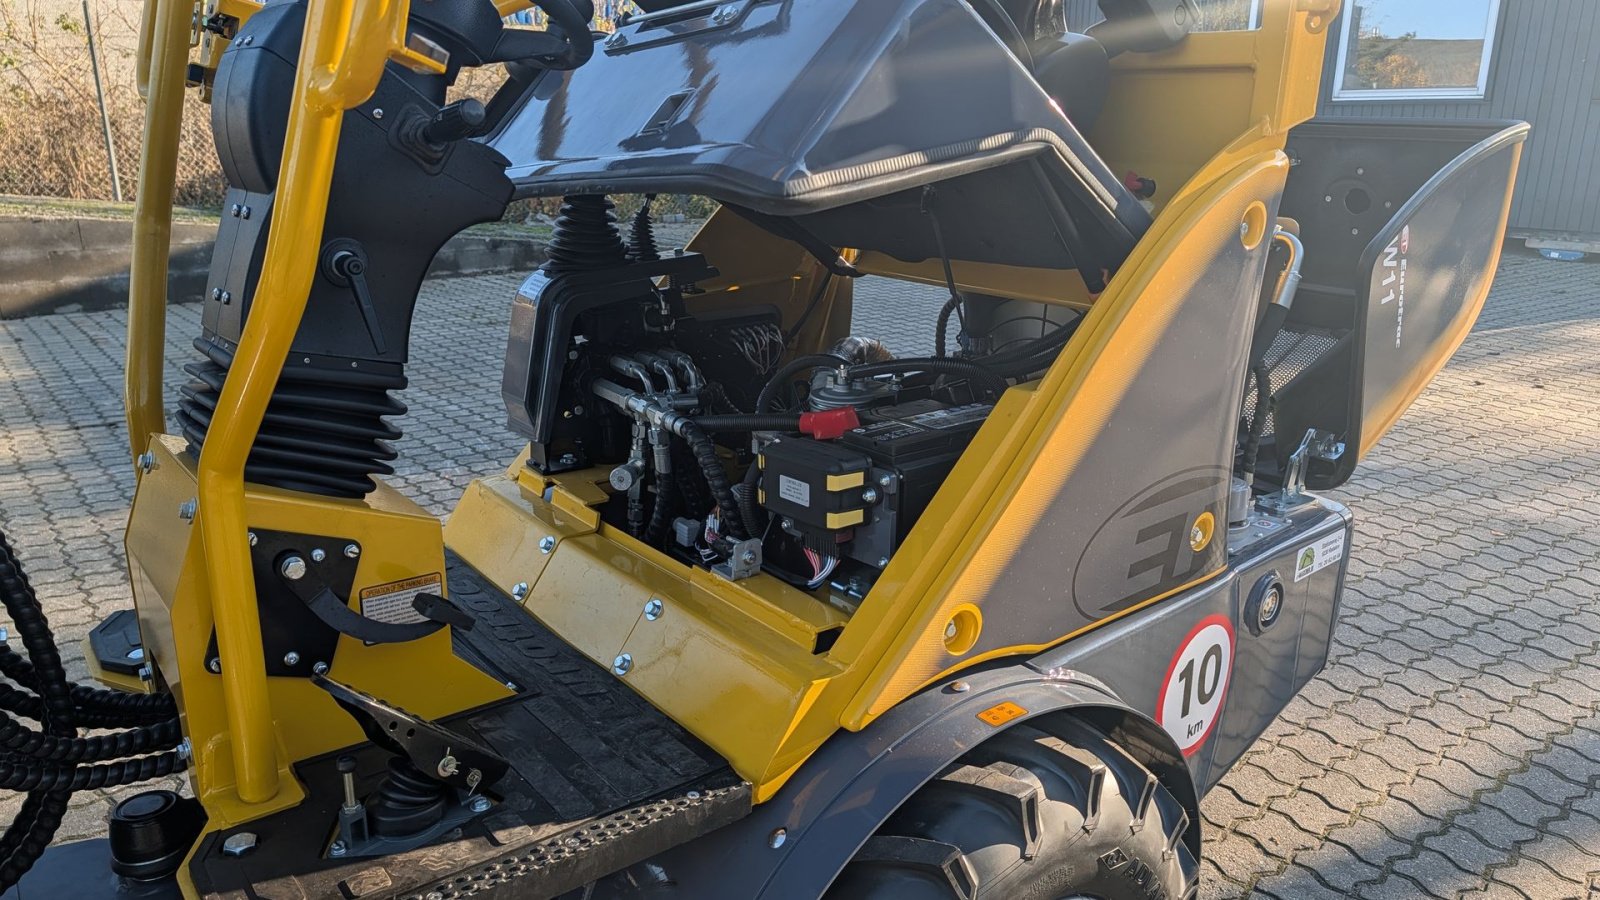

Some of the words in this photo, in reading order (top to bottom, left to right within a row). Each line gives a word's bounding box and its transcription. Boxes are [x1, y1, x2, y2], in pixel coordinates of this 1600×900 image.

[365, 585, 390, 599] OPERATION
[406, 578, 423, 589] PARKING
[423, 575, 439, 586] BRAKE
[1178, 643, 1223, 719] 10
[1186, 719, 1204, 739] km
